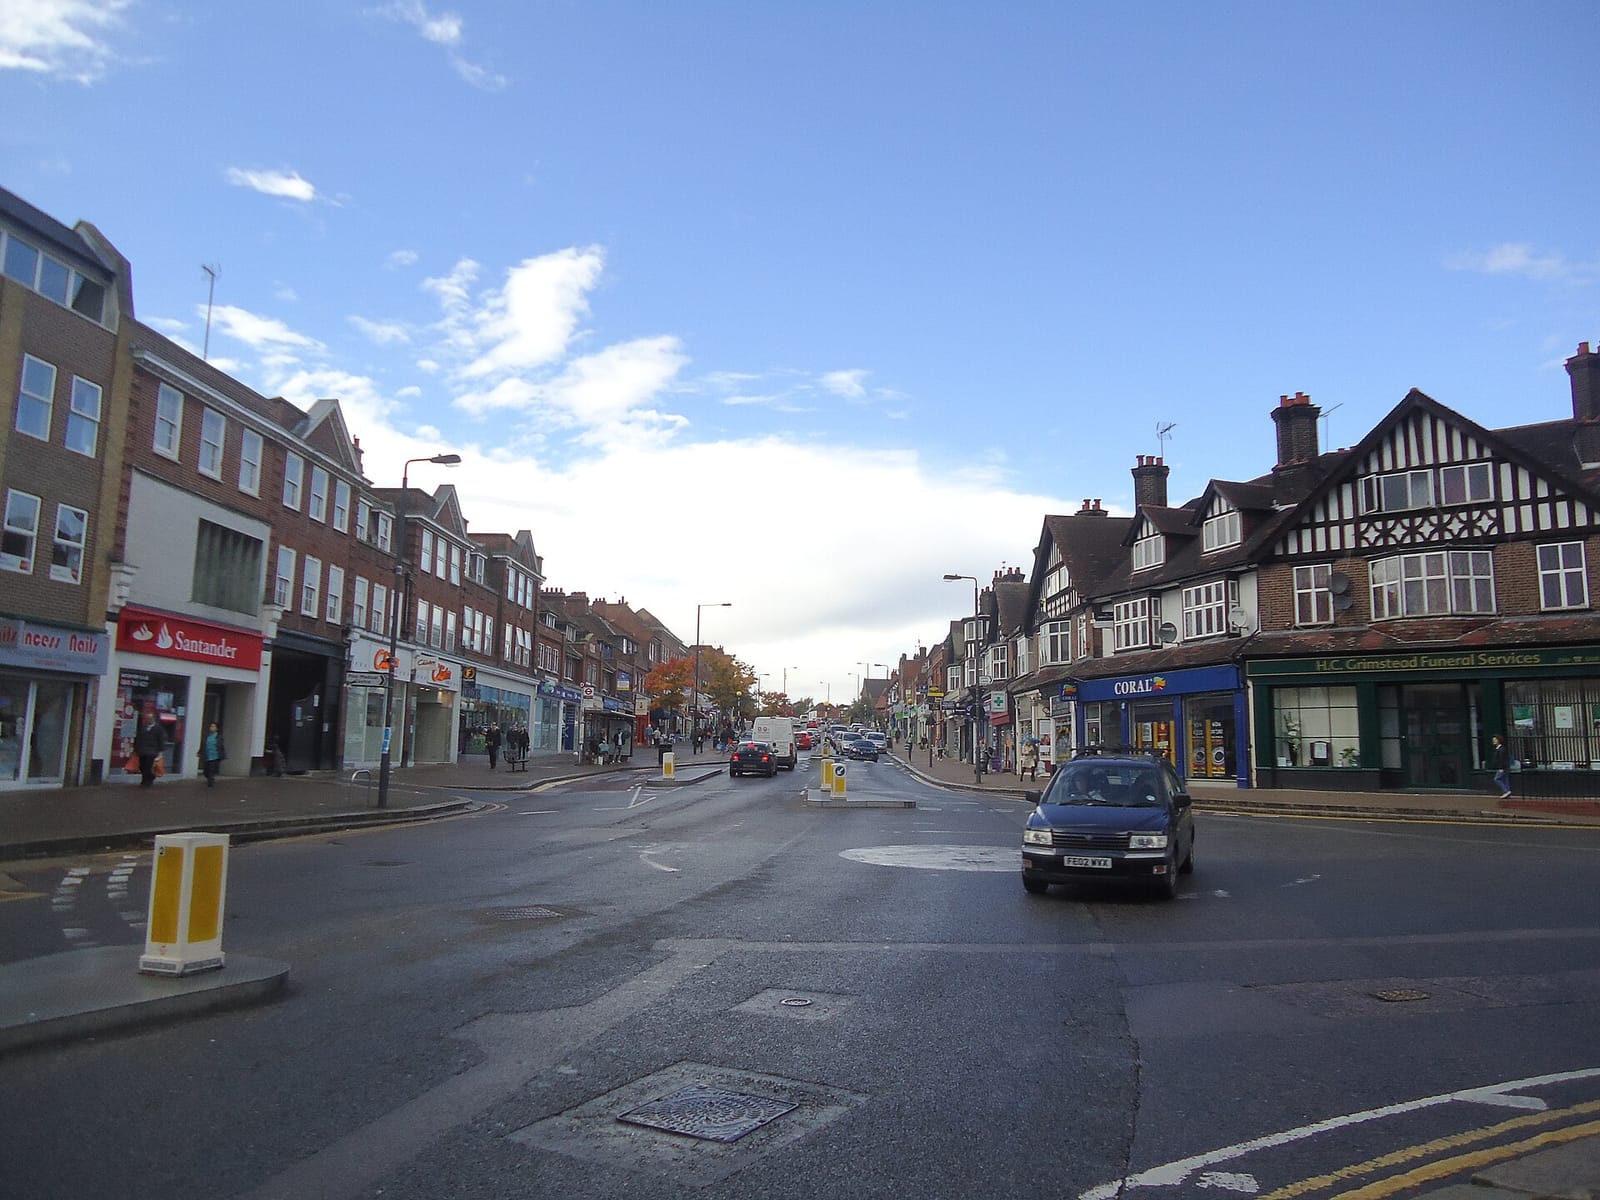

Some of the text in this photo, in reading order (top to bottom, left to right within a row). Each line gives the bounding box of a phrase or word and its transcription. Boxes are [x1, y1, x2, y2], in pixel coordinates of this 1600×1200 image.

[69, 633, 97, 653] Nails
[175, 631, 237, 658] Santander
[1346, 656, 1417, 670] Grimstead
[1421, 654, 1474, 668] Funeral
[1477, 652, 1541, 666] Services
[1114, 679, 1152, 694] CORAL
